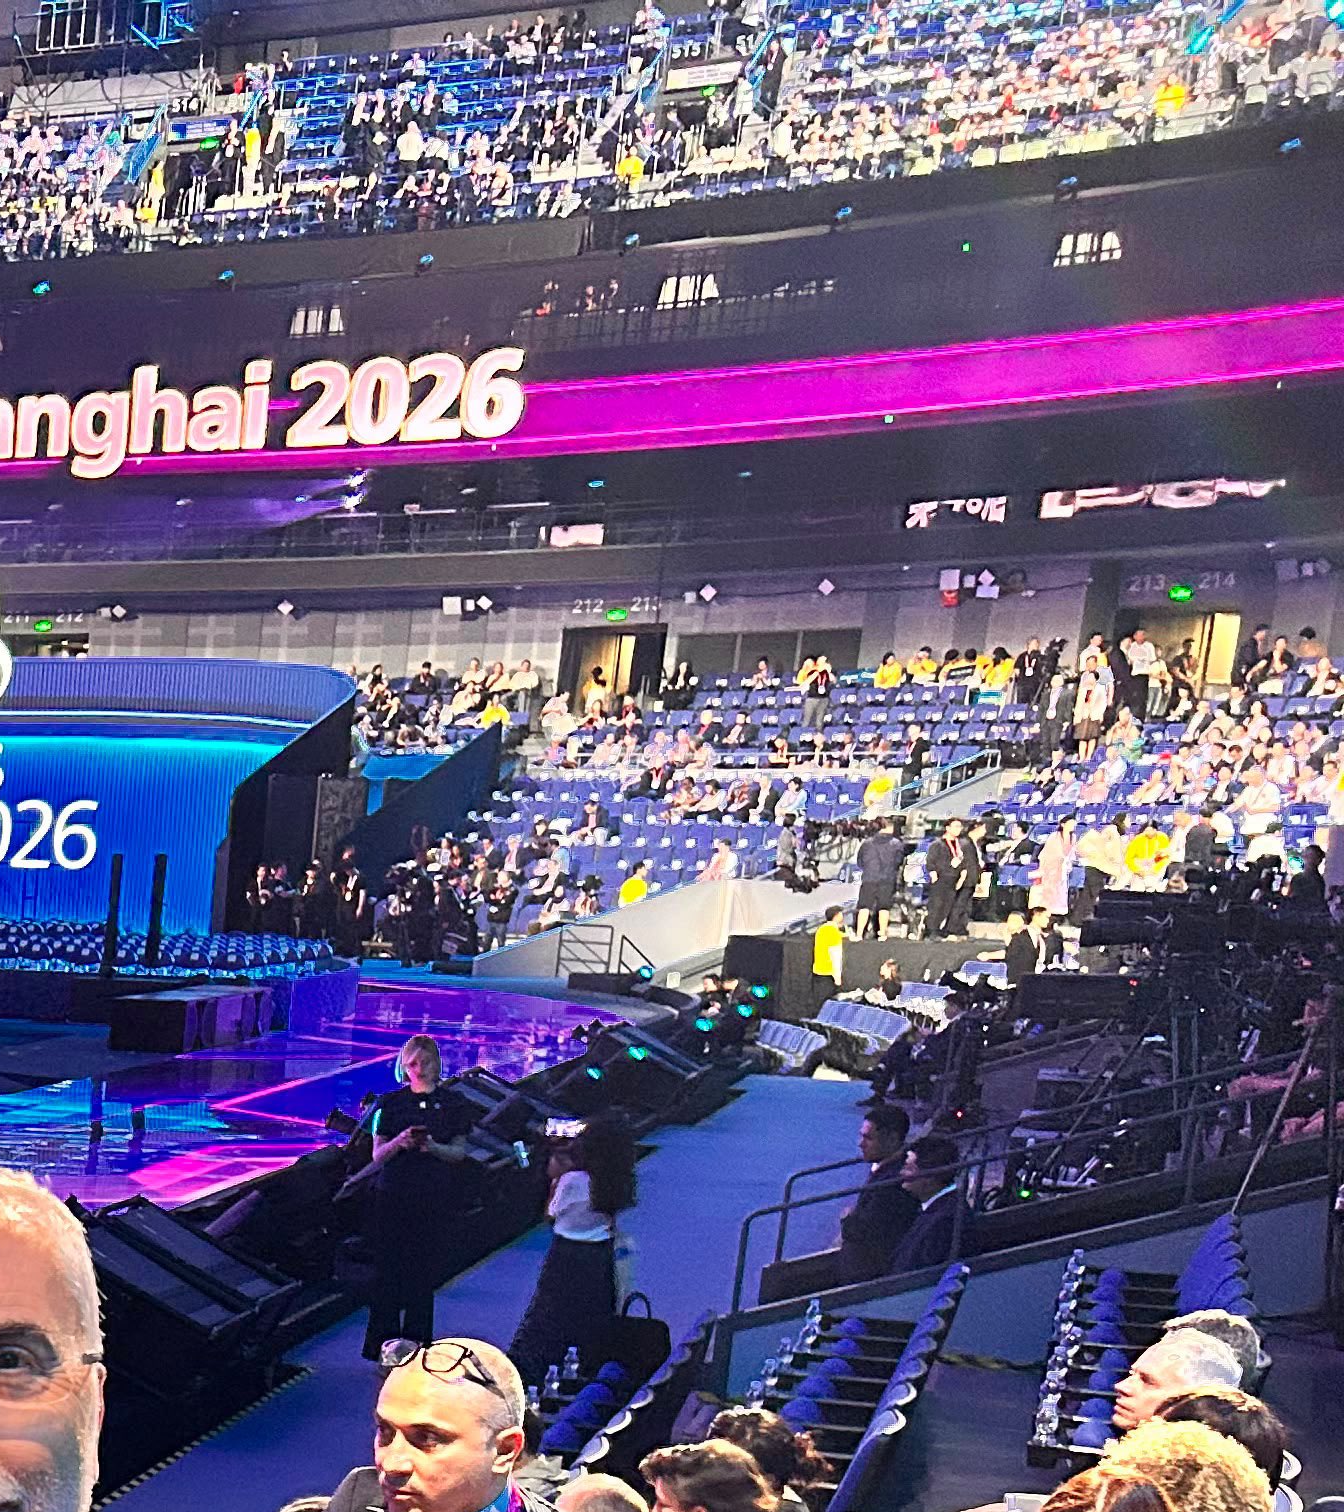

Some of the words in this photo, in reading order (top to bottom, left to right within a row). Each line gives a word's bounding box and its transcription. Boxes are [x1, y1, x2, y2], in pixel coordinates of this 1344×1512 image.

[671, 42, 702, 59] 515
[172, 98, 199, 113] 514
[286, 346, 527, 448] 2026
[572, 597, 604, 614] 212
